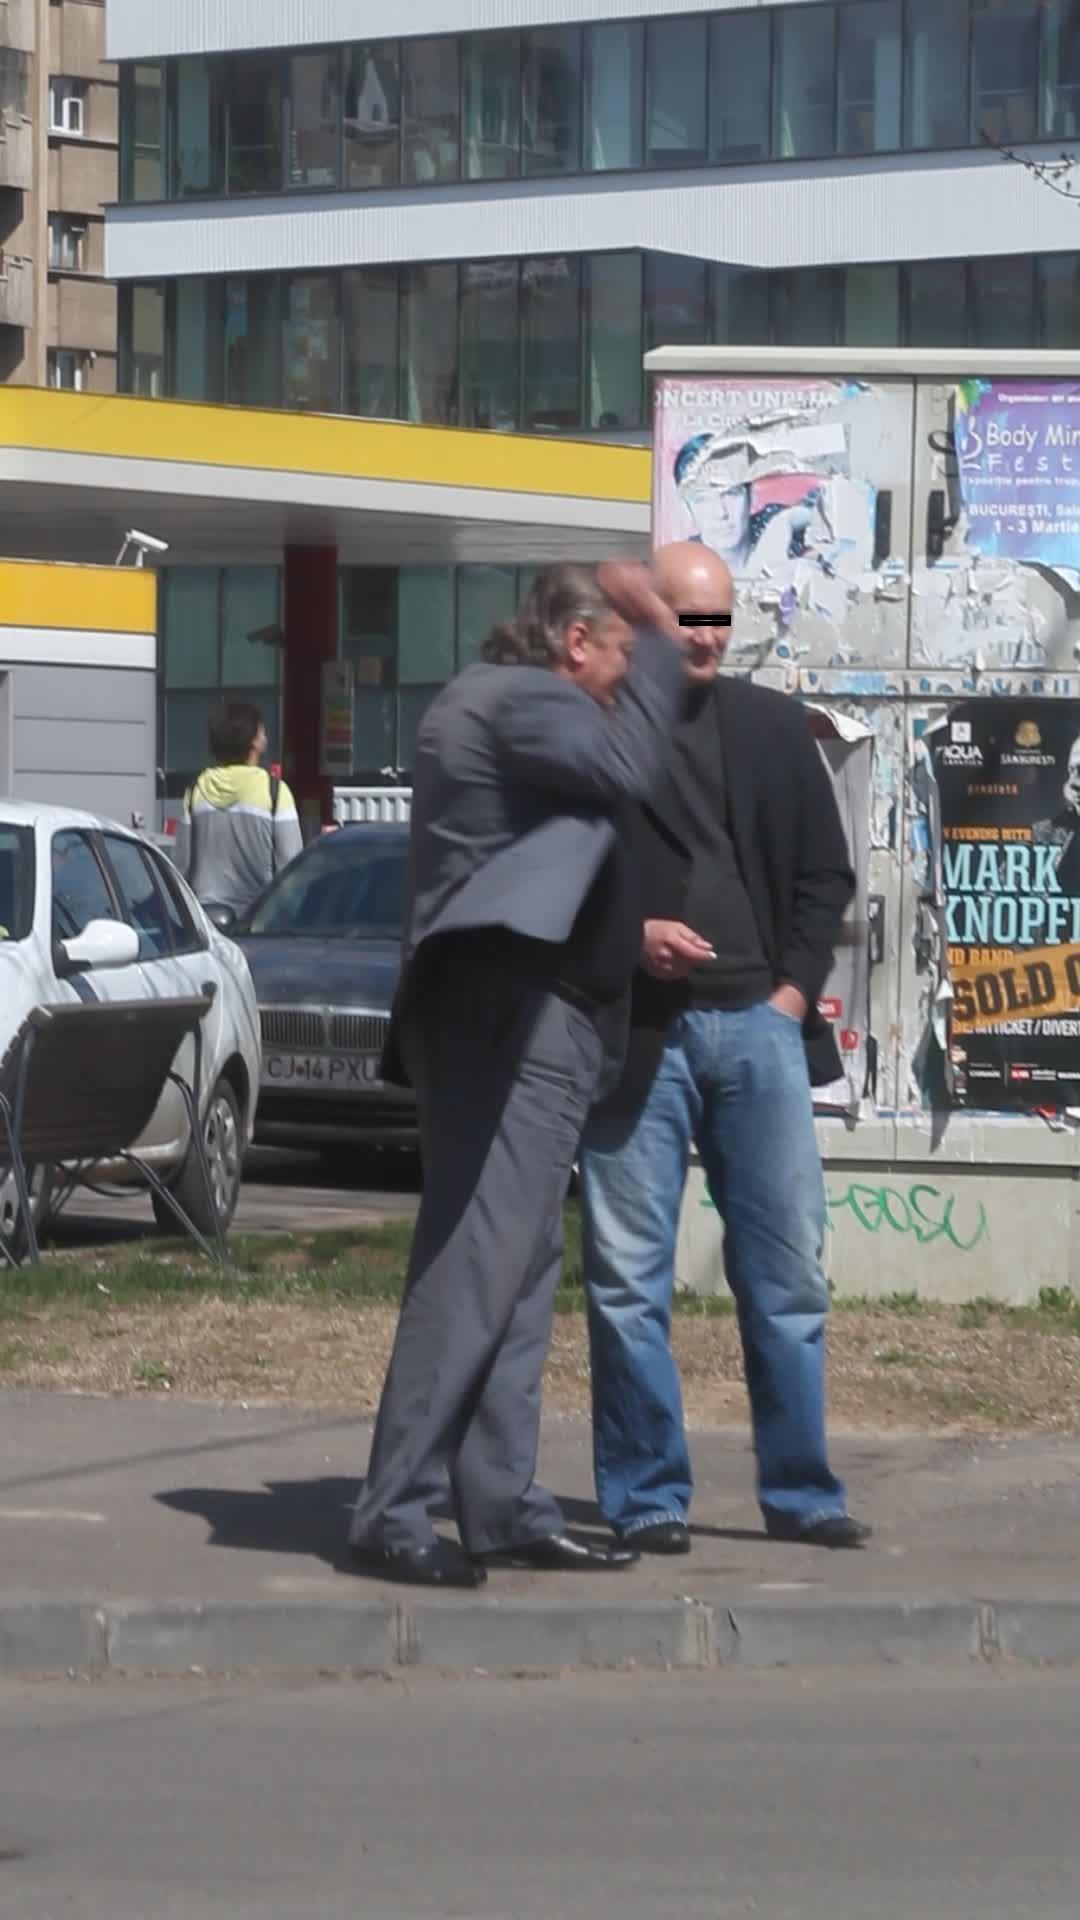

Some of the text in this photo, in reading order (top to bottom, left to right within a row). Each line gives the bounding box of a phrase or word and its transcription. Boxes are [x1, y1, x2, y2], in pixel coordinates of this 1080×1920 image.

[987, 422, 1038, 453] Body
[1017, 519, 1027, 534] 3
[943, 843, 1062, 892] MARK
[952, 961, 1056, 1021] SOLD
